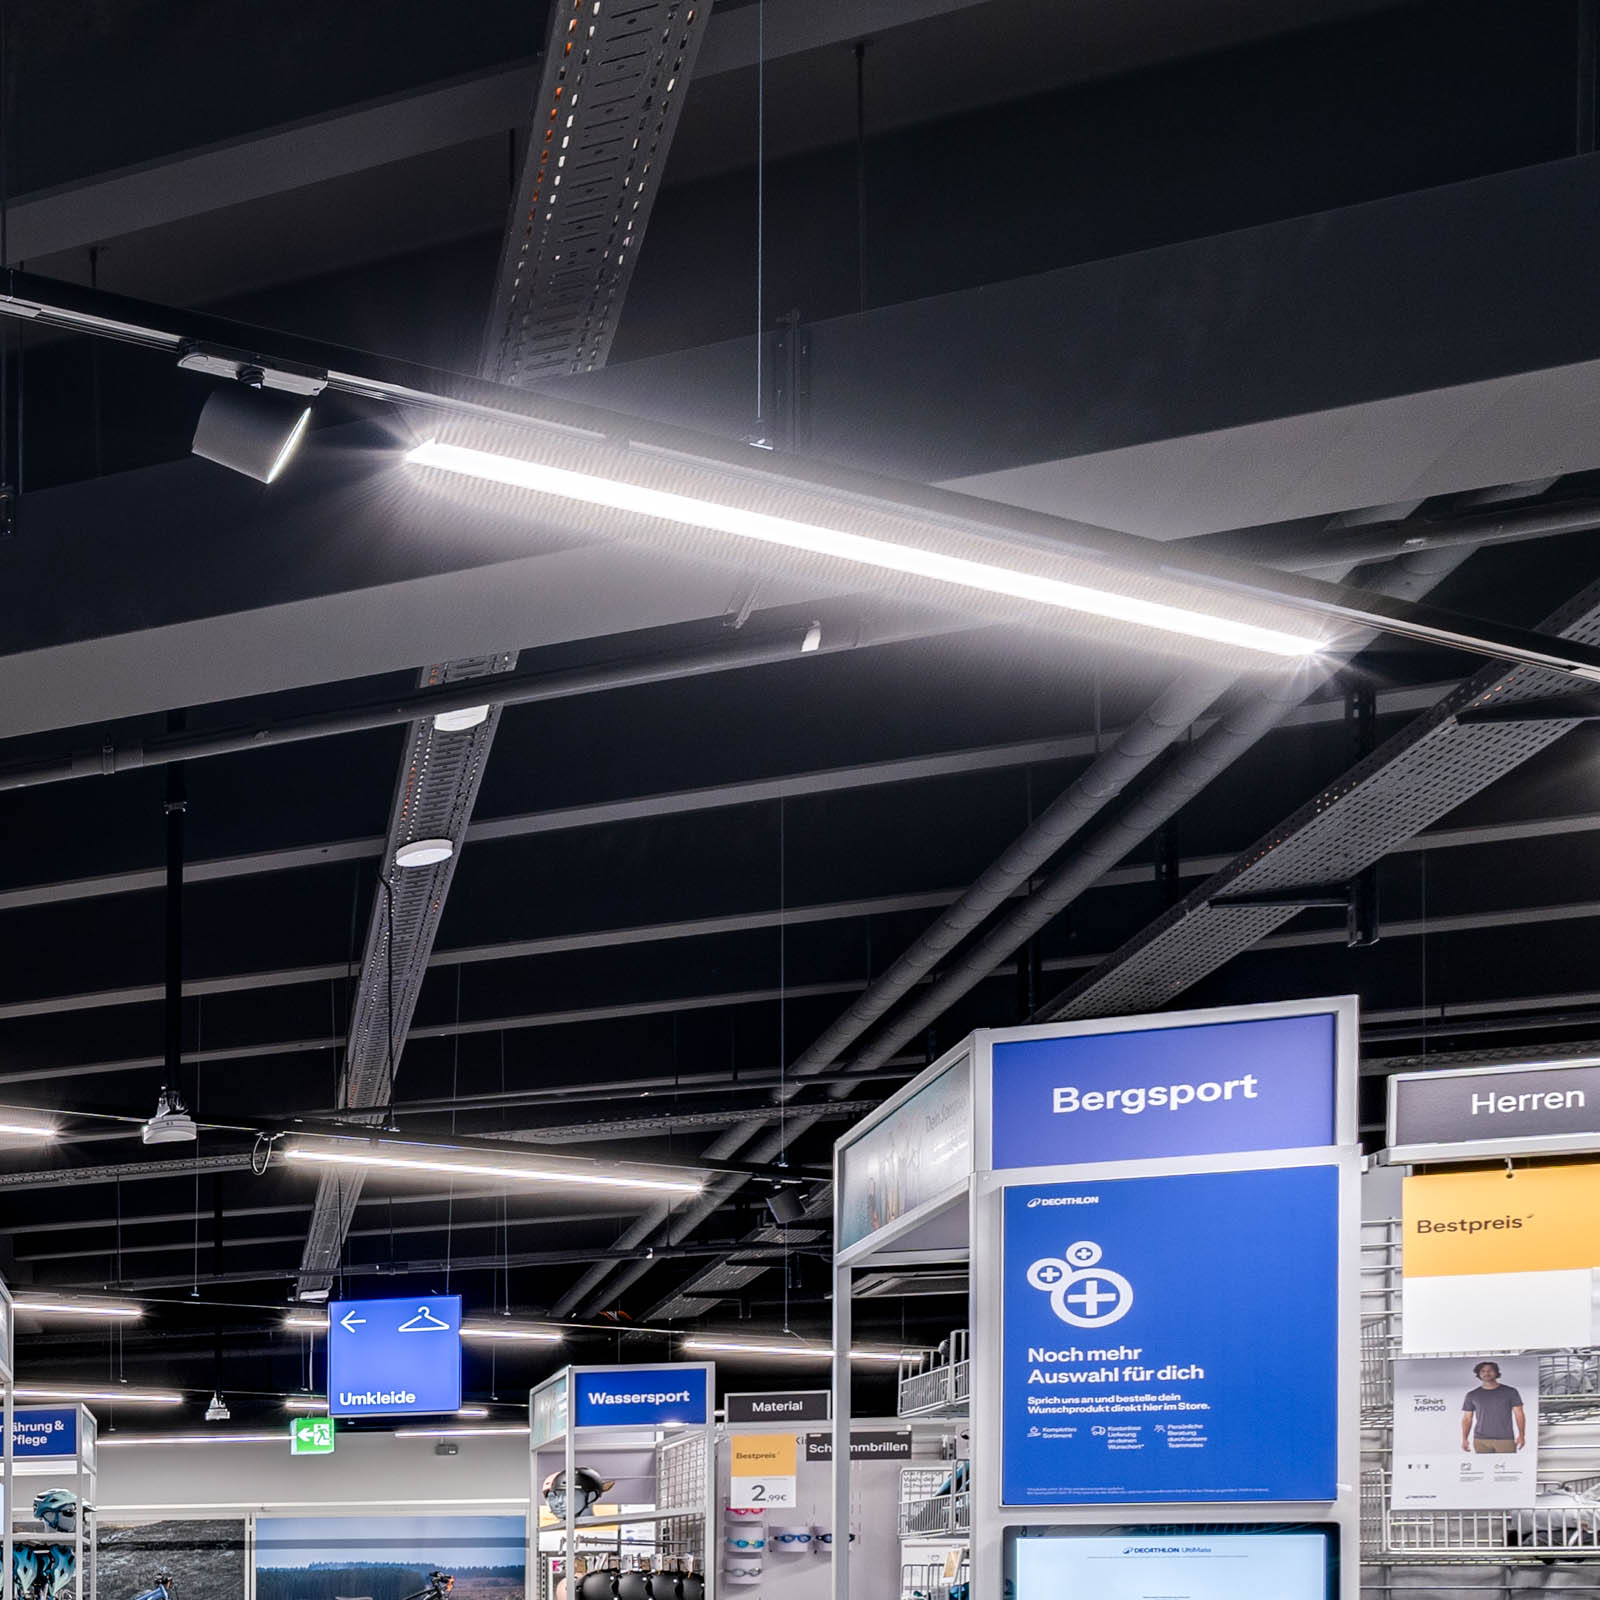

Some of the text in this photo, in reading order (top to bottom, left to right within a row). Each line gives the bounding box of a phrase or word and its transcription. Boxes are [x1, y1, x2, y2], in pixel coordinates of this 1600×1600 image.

[1052, 1073, 1258, 1115] Bergsport
[1471, 1090, 1585, 1116] Herren
[1041, 1196, 1099, 1206] DECATHLON
[1417, 1215, 1523, 1234] Bestpreis
[1028, 1345, 1142, 1363] Noch mehr
[1028, 1364, 1205, 1384] Auswahl für dich
[338, 1389, 417, 1407] Umkleide
[588, 1389, 690, 1407] Wassersport
[1028, 1396, 1061, 1407] Sprich
[1095, 1395, 1114, 1403] und
[1116, 1394, 1157, 1403] bestelle
[1159, 1393, 1181, 1402] dein
[751, 1400, 804, 1413] Material
[1028, 1402, 1211, 1415] Wunschprodukt direkt hier im Store.
[1414, 1404, 1447, 1412] MH100
[54, 1420, 64, 1432] &
[12, 1433, 47, 1447] Pflege
[808, 1440, 909, 1454] Schmmbrillen
[735, 1451, 777, 1461] Bestpreis
[1134, 1546, 1180, 1554] DECATHLON
